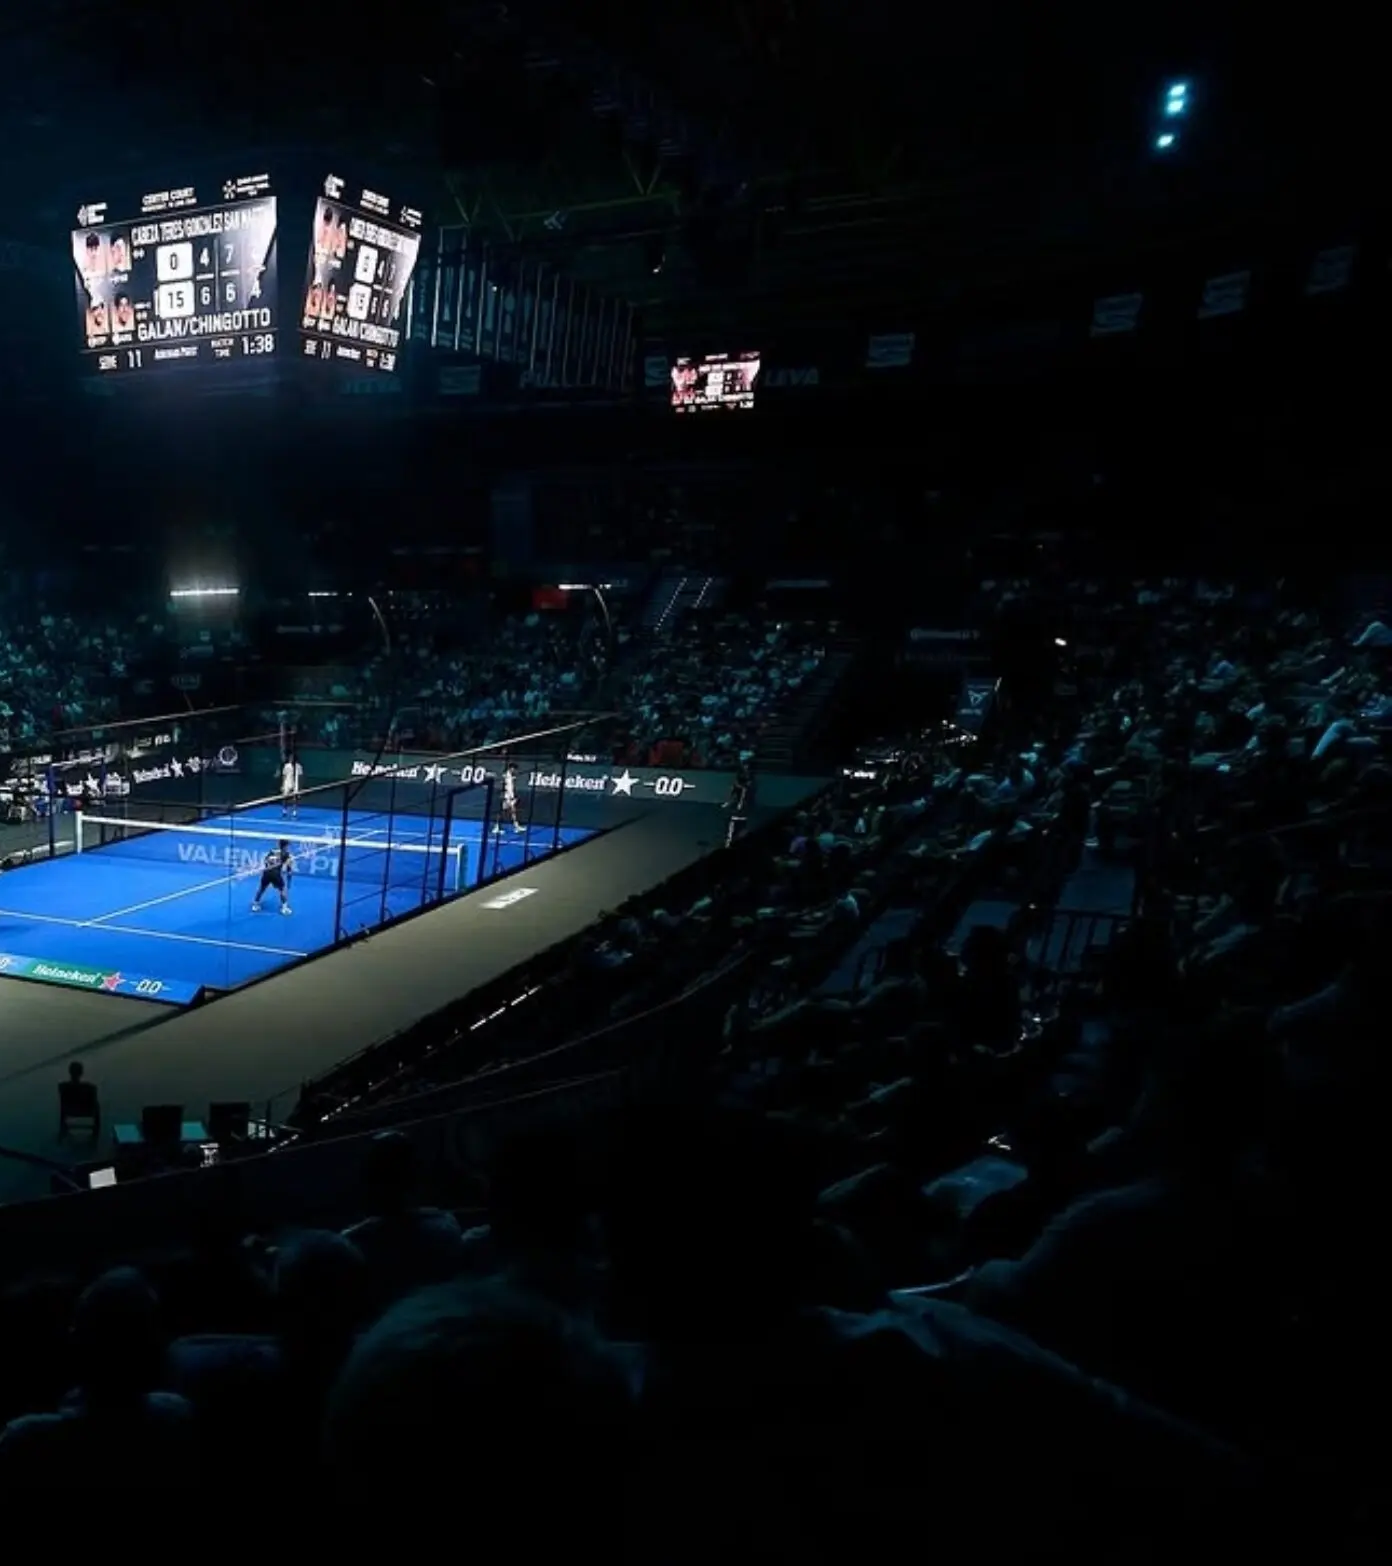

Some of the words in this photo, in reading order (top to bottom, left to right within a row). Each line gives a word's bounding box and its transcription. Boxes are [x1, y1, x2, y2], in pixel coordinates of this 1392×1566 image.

[170, 253, 178, 270] 0
[200, 247, 210, 267] 4
[224, 243, 234, 263] 7
[168, 290, 184, 308] 15
[201, 286, 211, 305] 6
[226, 282, 236, 301] 6
[137, 308, 271, 341] GALAN/CHINGOTTO
[242, 334, 275, 355] 1:38
[127, 349, 142, 368] 11
[32, 963, 100, 983] Heineken
